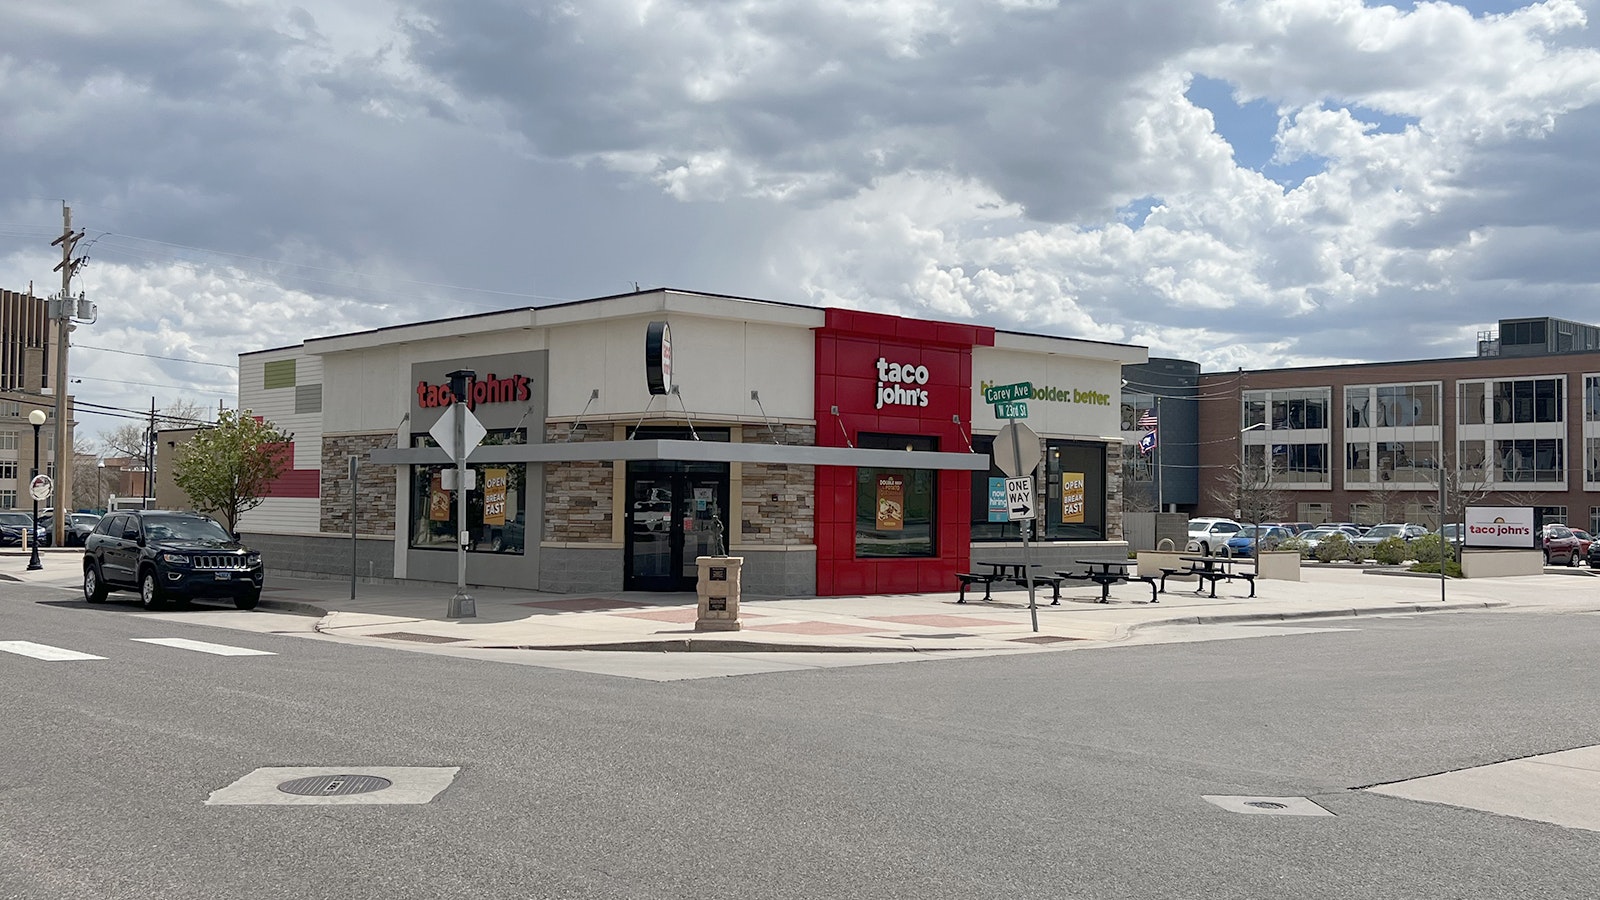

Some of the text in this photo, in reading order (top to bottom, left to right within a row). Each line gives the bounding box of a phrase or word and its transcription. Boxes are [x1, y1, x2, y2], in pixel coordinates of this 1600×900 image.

[877, 357, 929, 385] taco
[417, 374, 531, 413] tac john's
[876, 381, 929, 410] john's
[987, 388, 1011, 402] Carey
[1013, 384, 1029, 398] Ave
[1073, 388, 1110, 406] better.
[1006, 404, 1019, 417] 23rd
[1019, 404, 1027, 417] St
[485, 477, 506, 489] OPEN
[1008, 480, 1029, 492] ONE
[1064, 480, 1083, 490] OPEN
[486, 492, 505, 503] BREAK
[992, 490, 1005, 498] now
[1009, 491, 1030, 503] WAY
[1064, 494, 1083, 503] BREAK
[485, 502, 505, 517] FAST
[1064, 502, 1083, 515] FAST
[1470, 525, 1530, 536] taco john's
